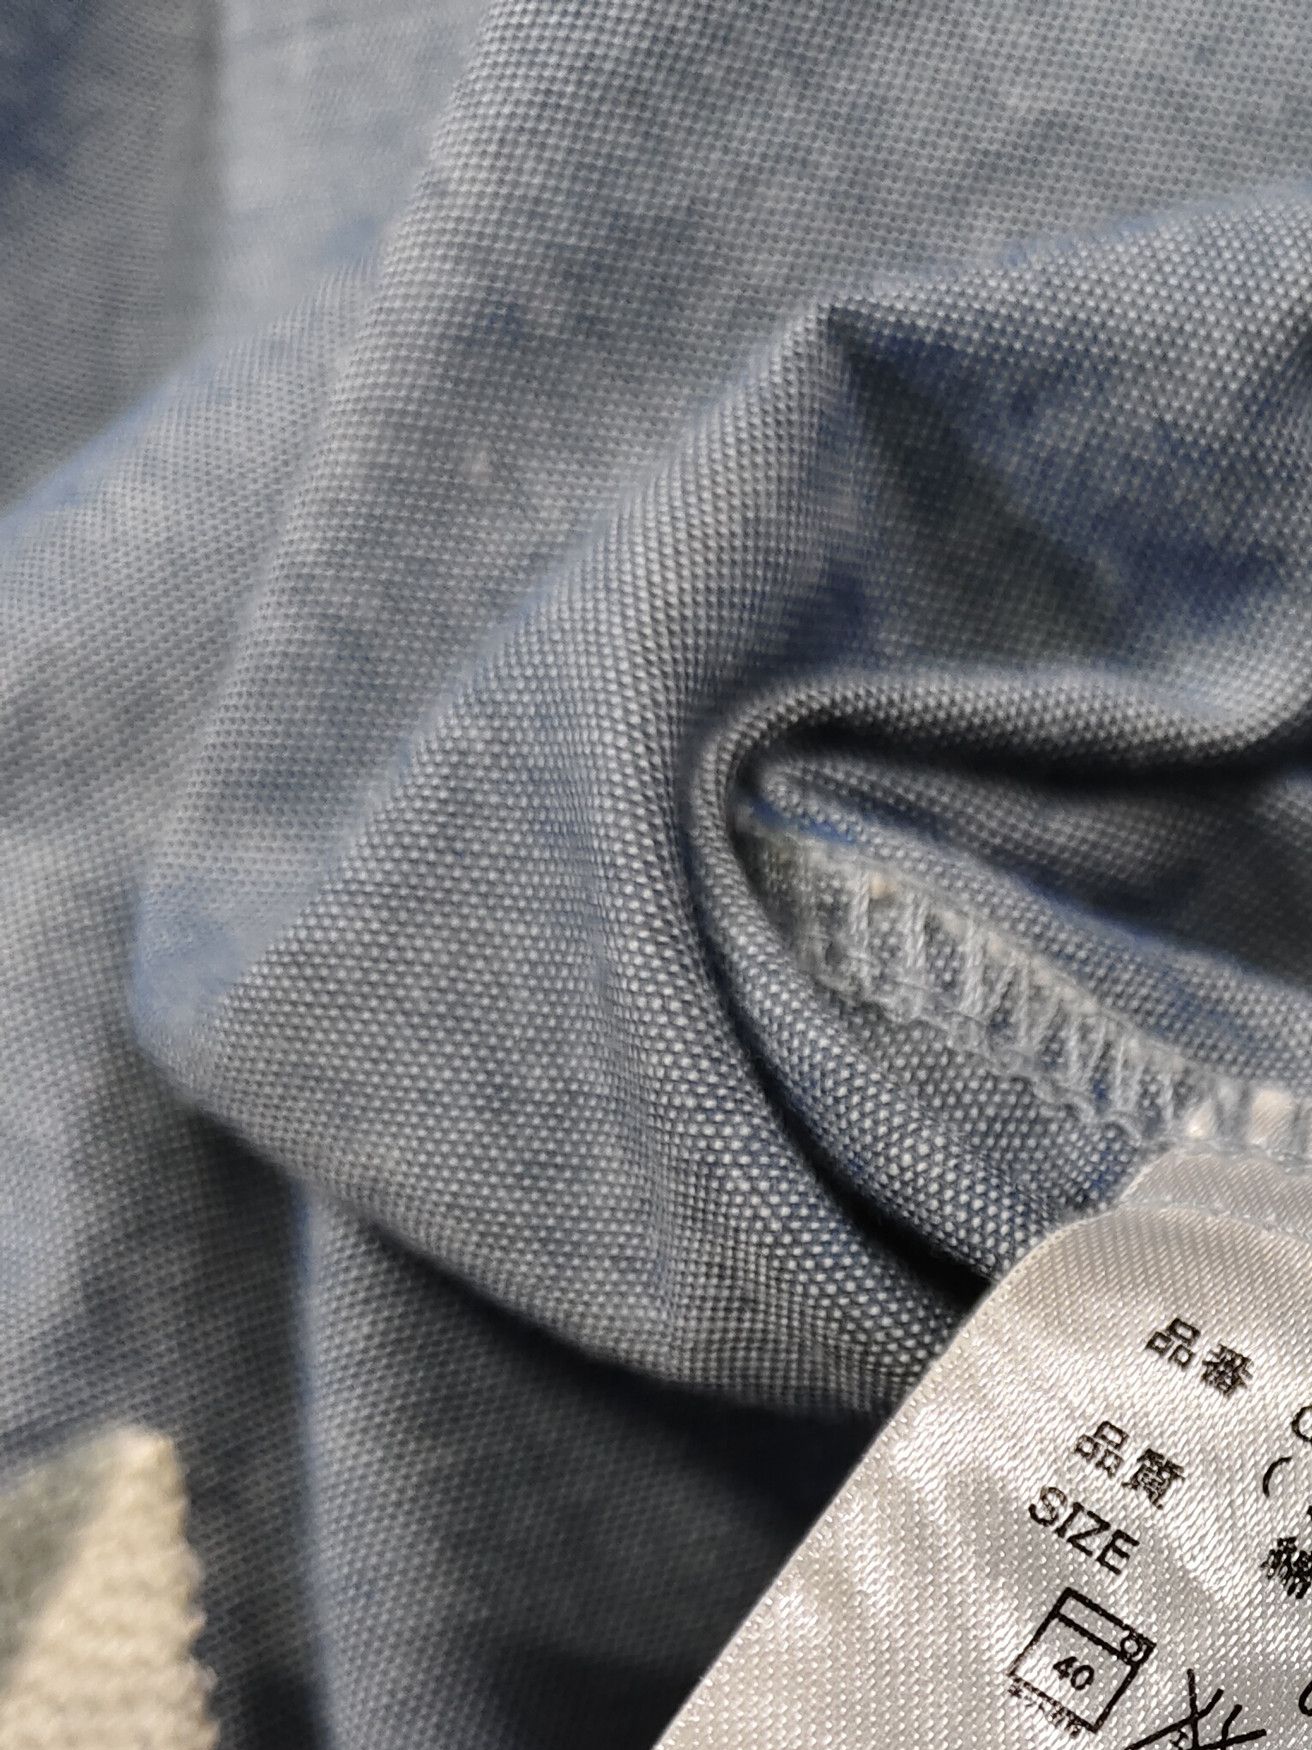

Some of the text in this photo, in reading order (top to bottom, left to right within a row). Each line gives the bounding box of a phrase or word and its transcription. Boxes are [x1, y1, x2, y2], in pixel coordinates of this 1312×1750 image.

[1144, 1317, 1255, 1399] 品番
[1075, 1420, 1185, 1509] 品質
[1028, 1486, 1140, 1576] SIZE
[1052, 1655, 1095, 1691] 40
